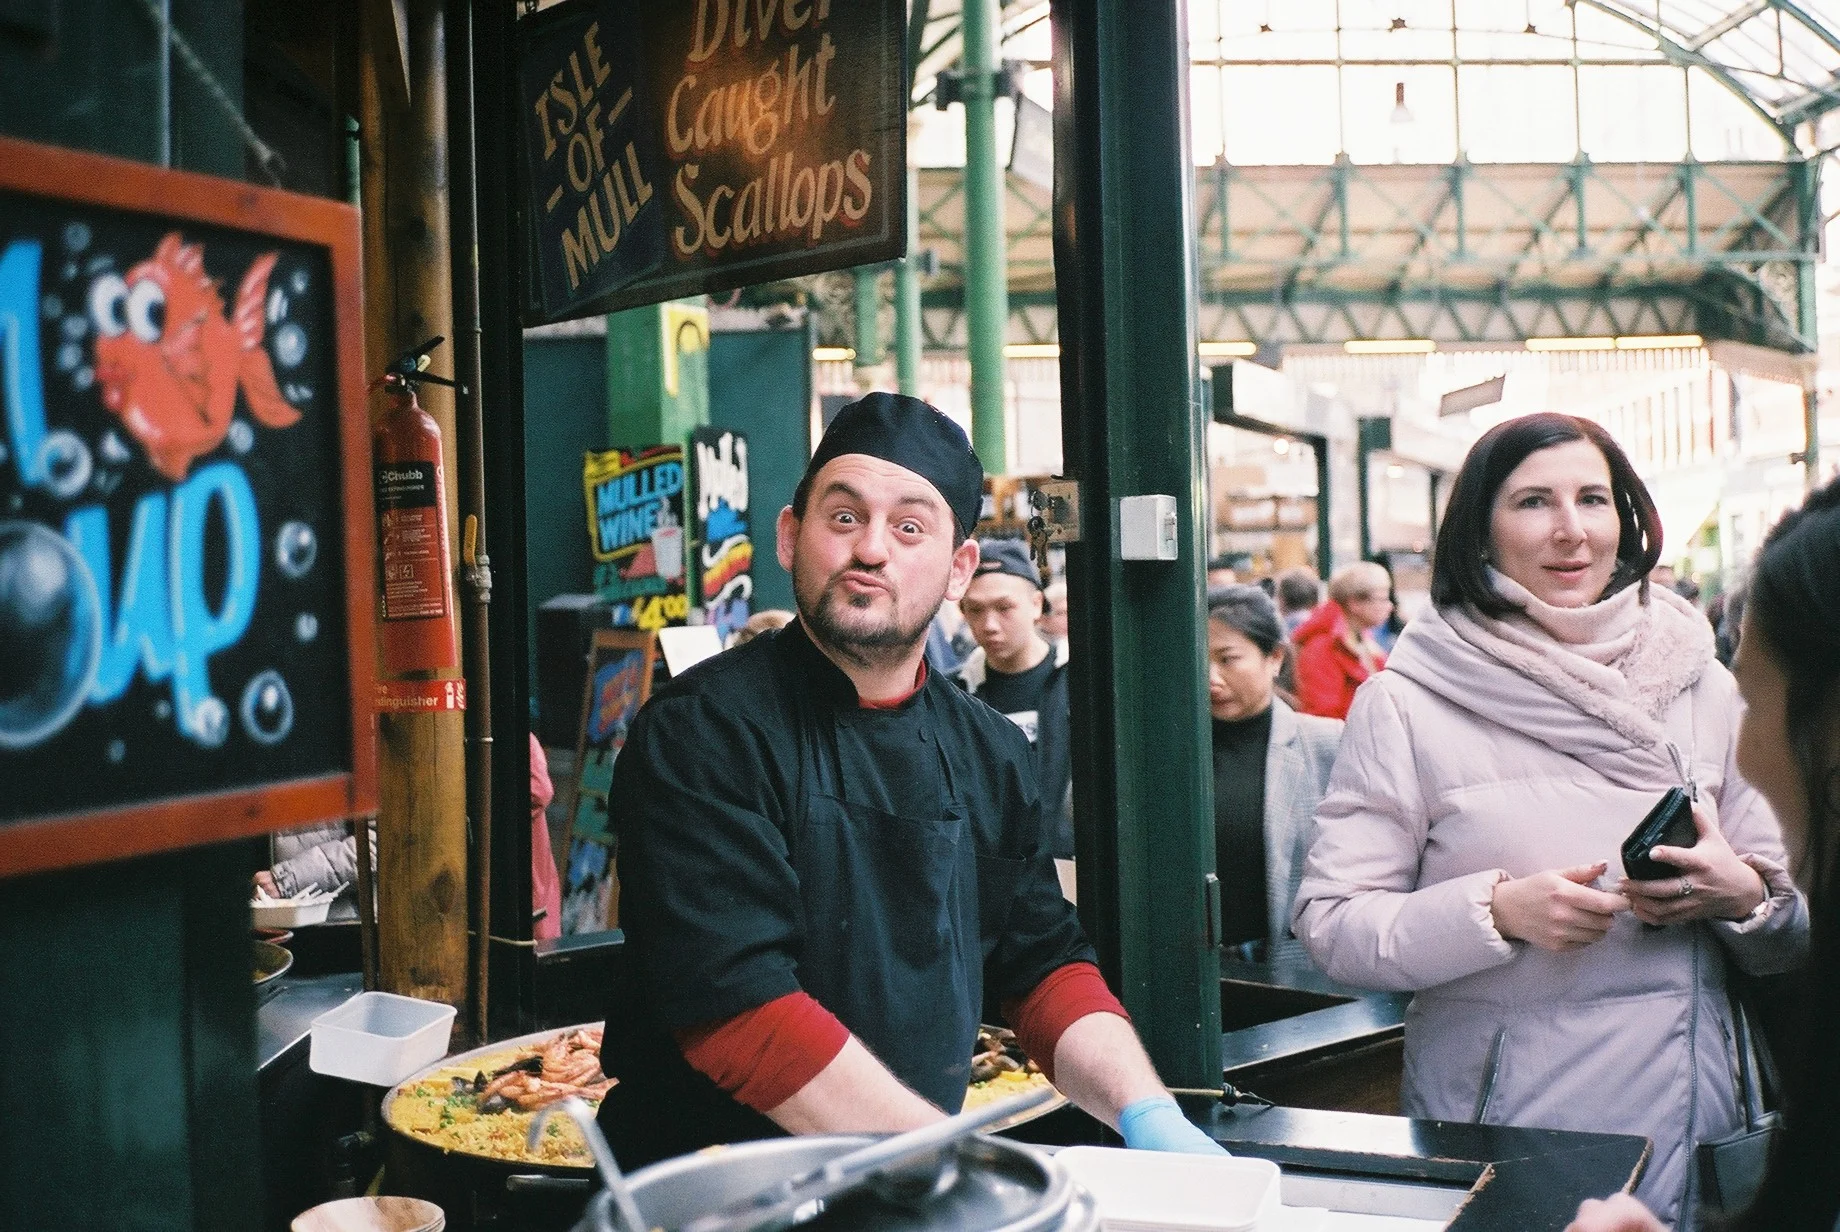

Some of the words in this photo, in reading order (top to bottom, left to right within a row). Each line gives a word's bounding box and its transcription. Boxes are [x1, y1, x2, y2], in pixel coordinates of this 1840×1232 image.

[534, 20, 611, 161] ISLE
[667, 32, 836, 156] Caught
[561, 142, 653, 291] MULL
[673, 148, 873, 255] Scallops
[387, 469, 424, 482] Chubb
[597, 461, 685, 516] MULLED
[599, 501, 661, 551] WINE
